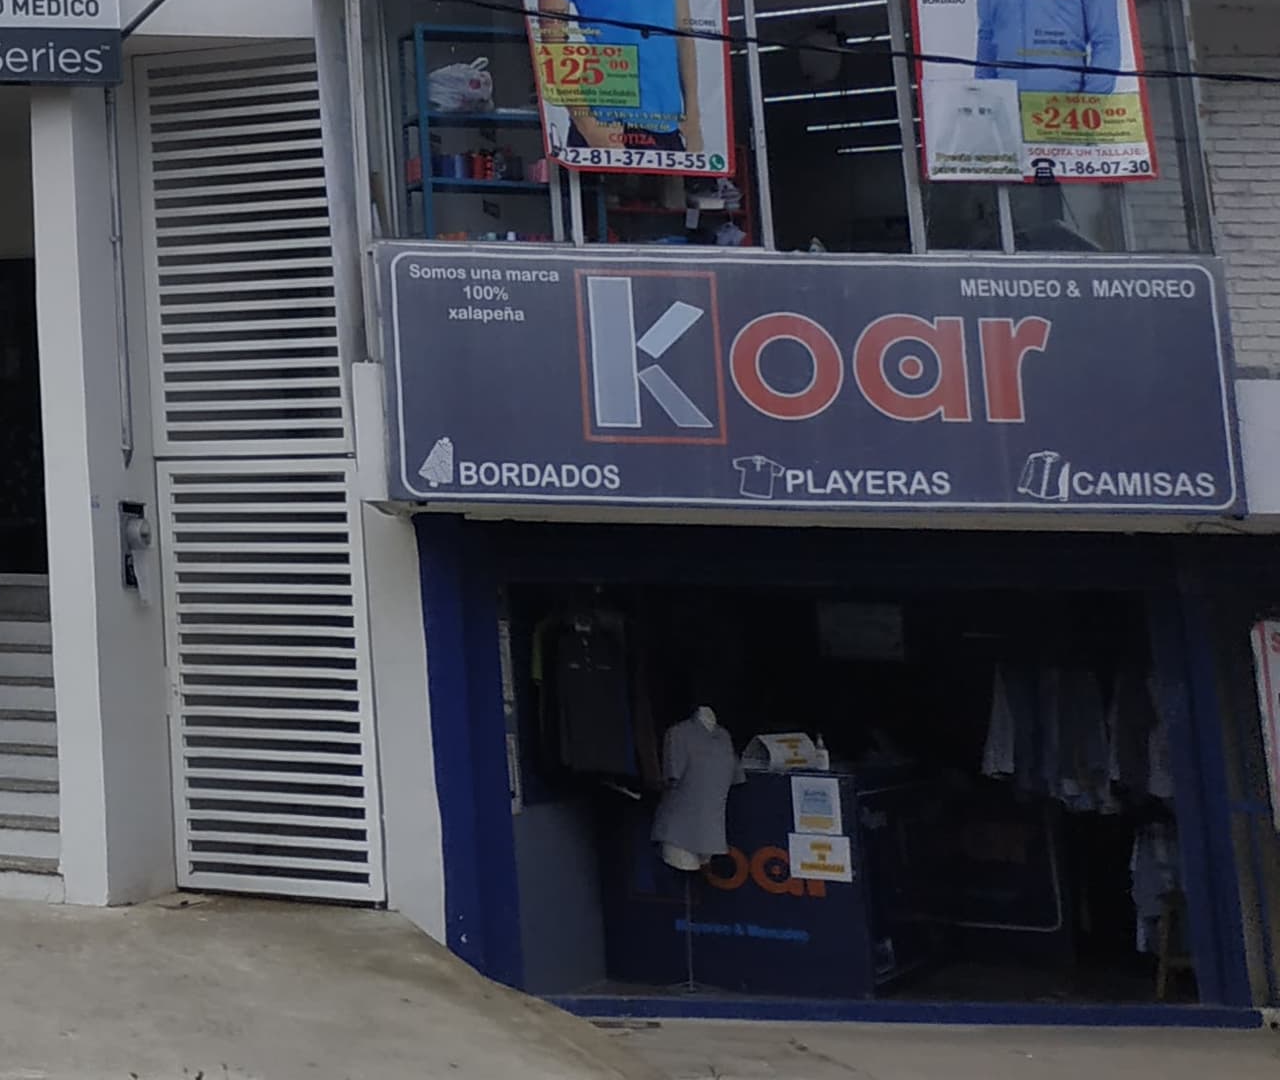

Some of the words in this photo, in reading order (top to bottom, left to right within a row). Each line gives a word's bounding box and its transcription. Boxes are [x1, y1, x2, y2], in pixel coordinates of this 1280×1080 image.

[1030, 106, 1102, 130] $240
[608, 133, 656, 145] COTIZA
[1027, 147, 1073, 156] SOLICITA
[1075, 148, 1092, 157] UN
[1096, 148, 1141, 156] TALLAJE
[409, 263, 466, 280] Somos
[471, 268, 503, 282] una
[506, 268, 559, 283] marca
[463, 285, 509, 301] 100%
[960, 279, 1061, 298] MENUDEO
[1066, 281, 1081, 298] &
[1093, 280, 1196, 299] MAYOREO
[448, 305, 525, 323] xalapeña
[459, 461, 621, 489] BORDADOS
[785, 469, 952, 495] PLAYERAS
[1072, 471, 1216, 497] CAMISAS
